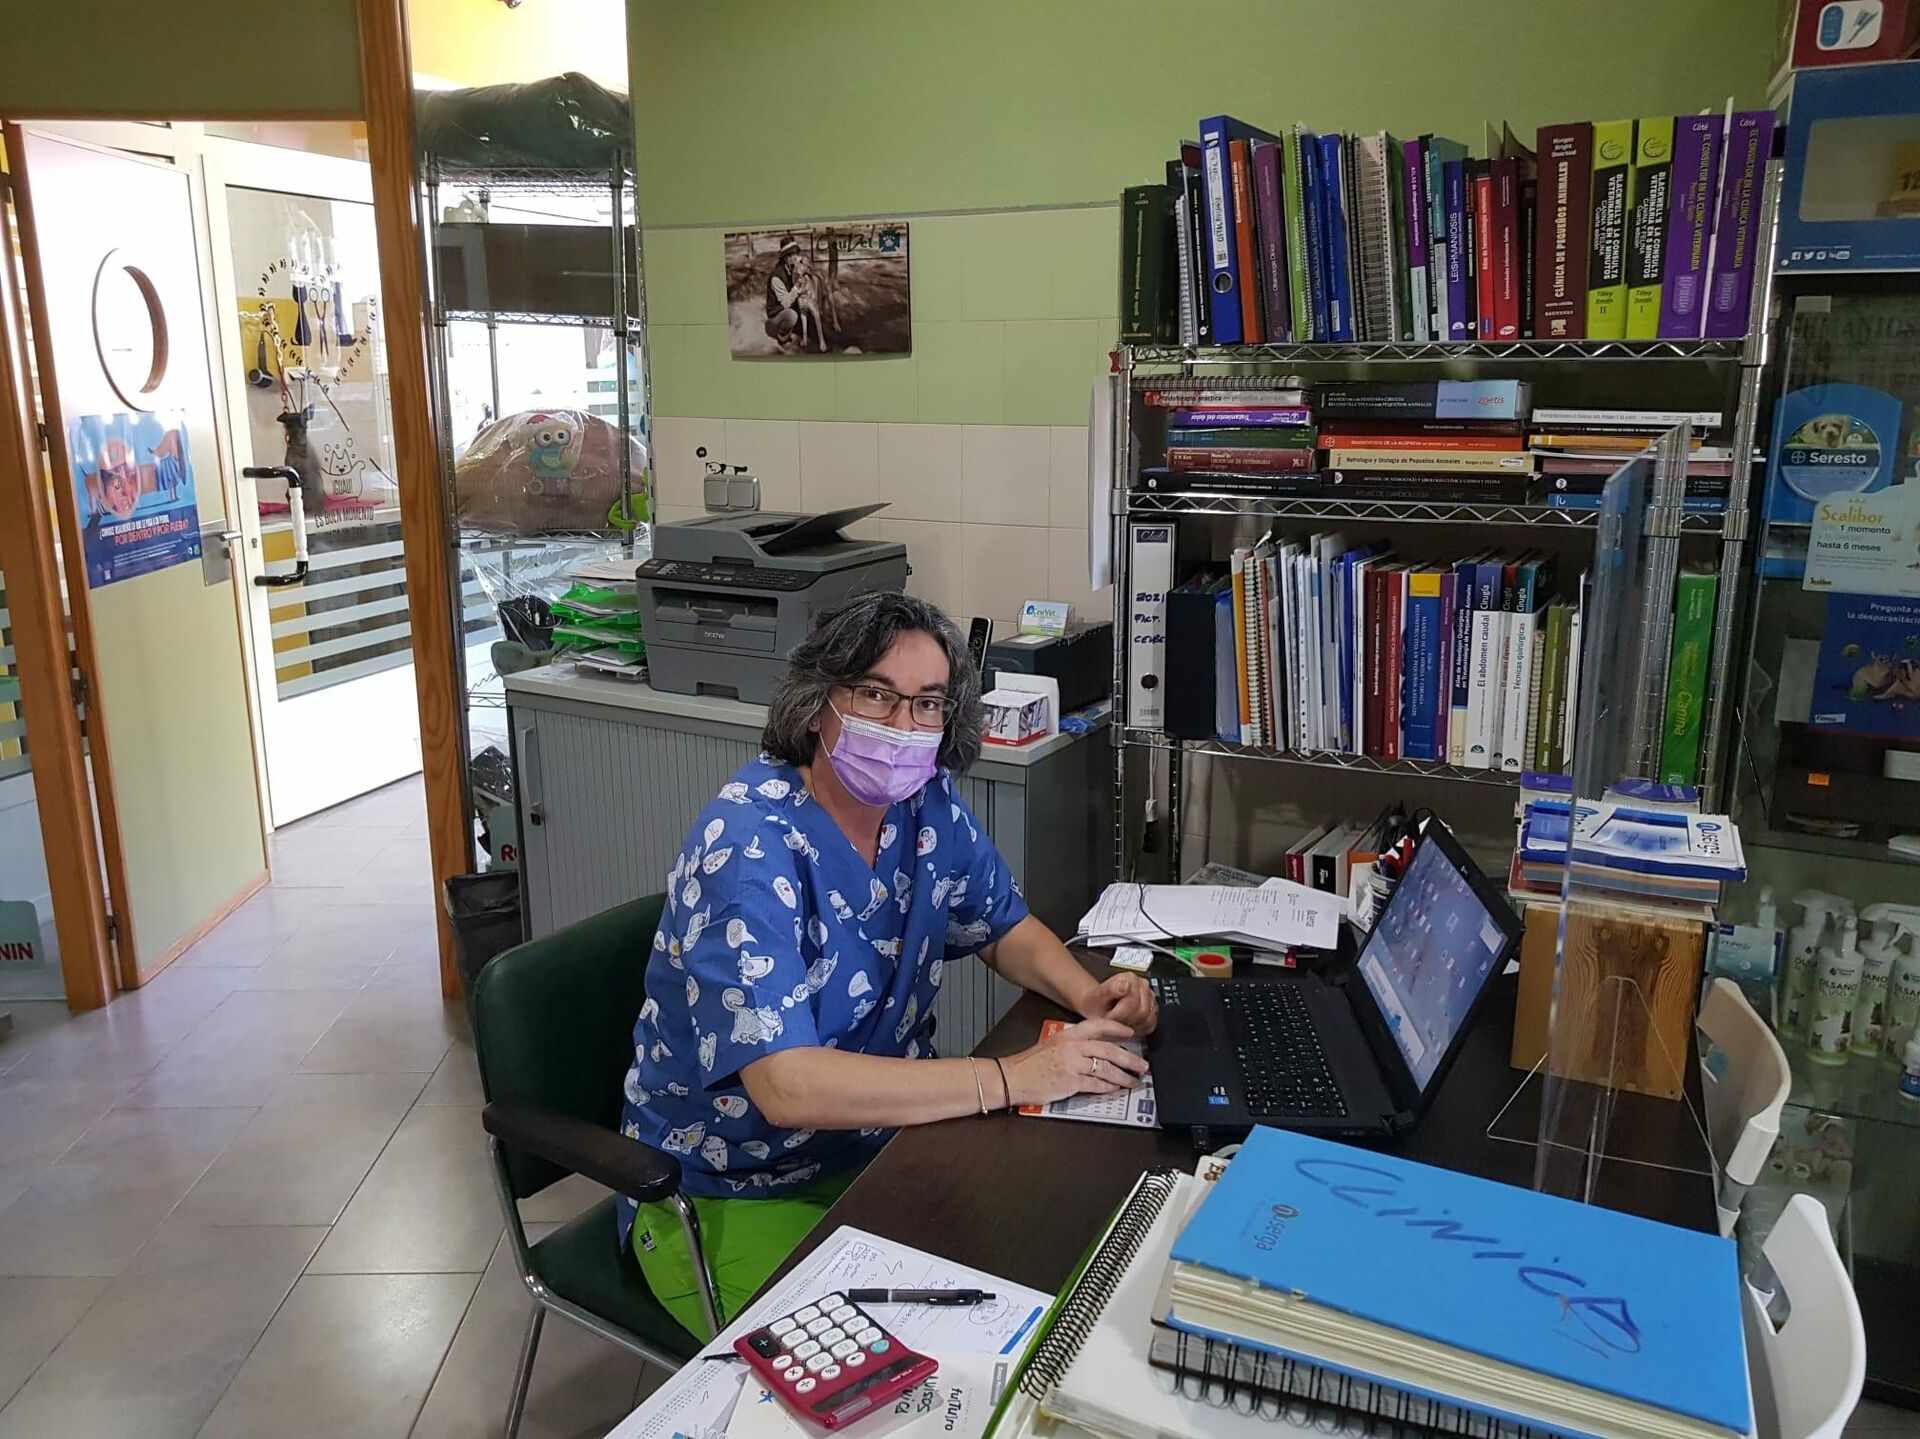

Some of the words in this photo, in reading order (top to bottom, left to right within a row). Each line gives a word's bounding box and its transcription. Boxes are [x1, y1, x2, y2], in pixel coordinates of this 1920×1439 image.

[1555, 161, 1568, 204] ANIMALES
[1555, 206, 1567, 249] PEQUEÑOS
[1613, 228, 1621, 237] LA
[1654, 228, 1662, 236] LA
[1450, 212, 1459, 282] LEISHMANIOSIS
[1556, 251, 1566, 262] DE
[1611, 239, 1620, 279] CONSULTA
[1651, 238, 1661, 278] CONSULTA
[1603, 245, 1613, 280] MINUTOS
[1643, 244, 1653, 279] MINUTOS
[1553, 264, 1566, 297] CLÍNICA
[1809, 452, 1867, 464] Seresto
[315, 513, 324, 528] ES
[1821, 505, 1884, 524] Scalibor
[1848, 526, 1891, 534] momento
[1817, 541, 1841, 550] hasta
[1844, 542, 1849, 550] 6
[1852, 543, 1881, 552] meses
[1136, 593, 1165, 603] 2021
[1480, 584, 1490, 610] Cirugía
[1517, 588, 1526, 612] Cirugía
[1870, 603, 1911, 614] Pregunta
[704, 631, 726, 640] brother
[1464, 635, 1469, 643] de
[1480, 614, 1490, 640] caudal
[1456, 640, 1464, 666] Abordajes
[1516, 622, 1526, 660] quirúrgicas
[1478, 642, 1488, 678] abdomen
[1514, 661, 1523, 690] Técnicas
